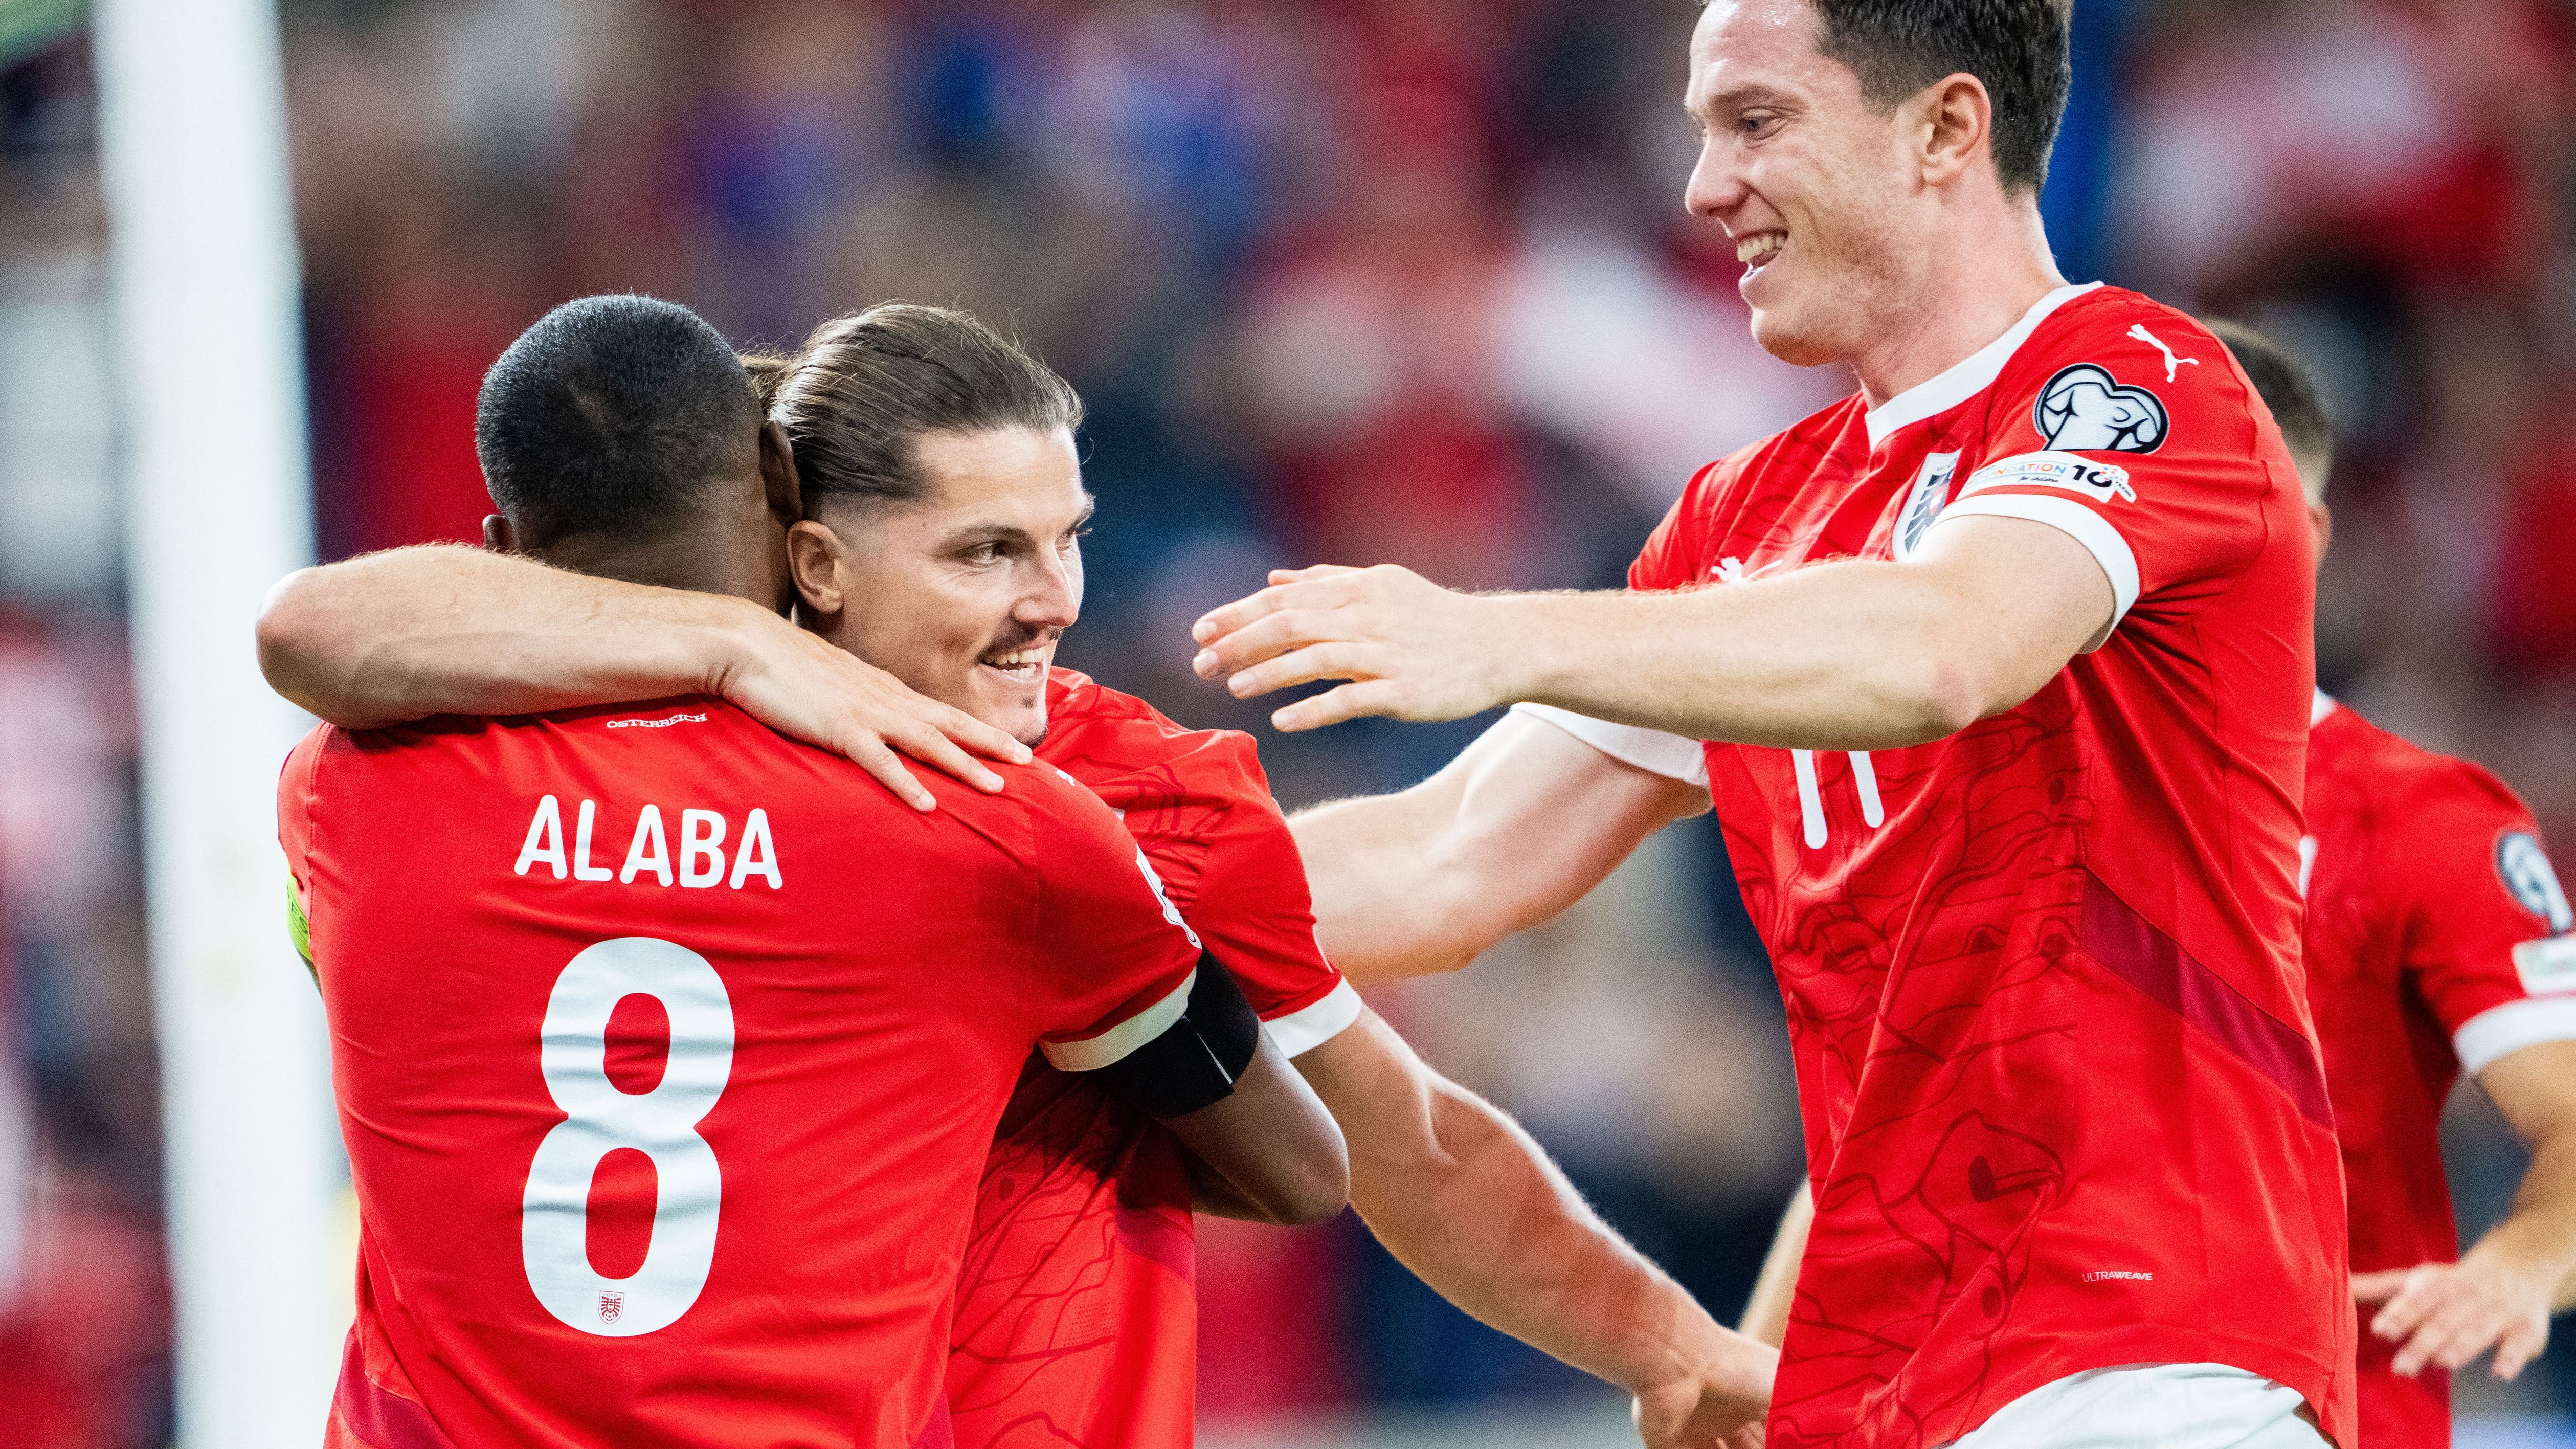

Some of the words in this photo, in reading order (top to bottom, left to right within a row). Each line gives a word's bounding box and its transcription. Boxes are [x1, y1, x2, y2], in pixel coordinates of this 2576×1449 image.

[607, 713, 708, 728] ÖSTERREICH
[514, 794, 783, 889] ALABA
[522, 937, 735, 1337] 8
[2082, 1271, 2152, 1282] ULTRAWEAVE
